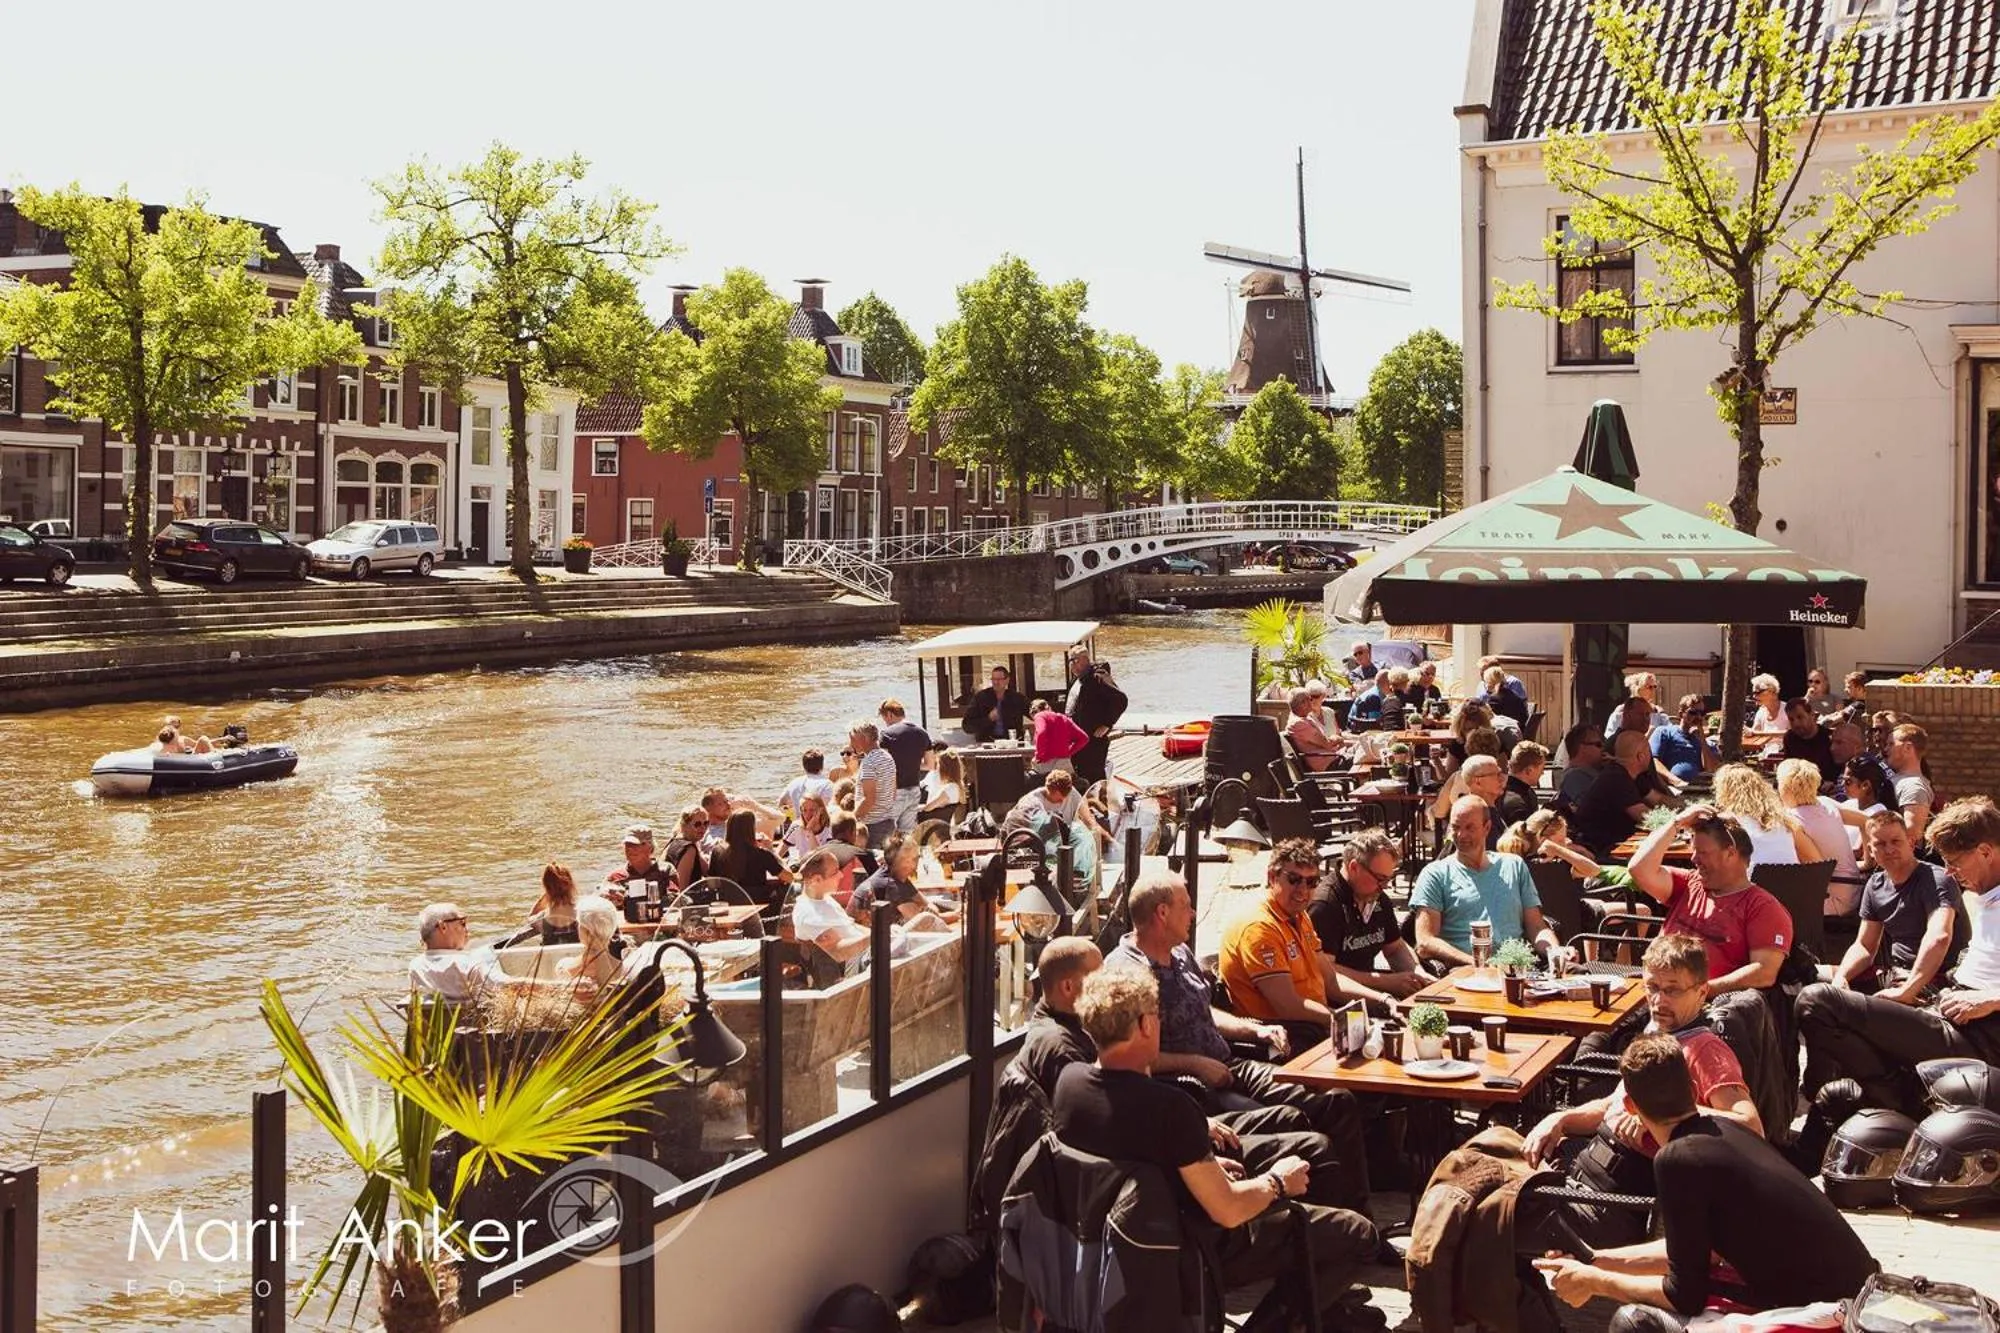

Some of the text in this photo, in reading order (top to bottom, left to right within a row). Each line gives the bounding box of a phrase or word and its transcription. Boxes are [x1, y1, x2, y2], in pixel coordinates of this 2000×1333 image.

[1479, 531, 1713, 541] TRADE MARK
[1789, 609, 1849, 625] Heineken
